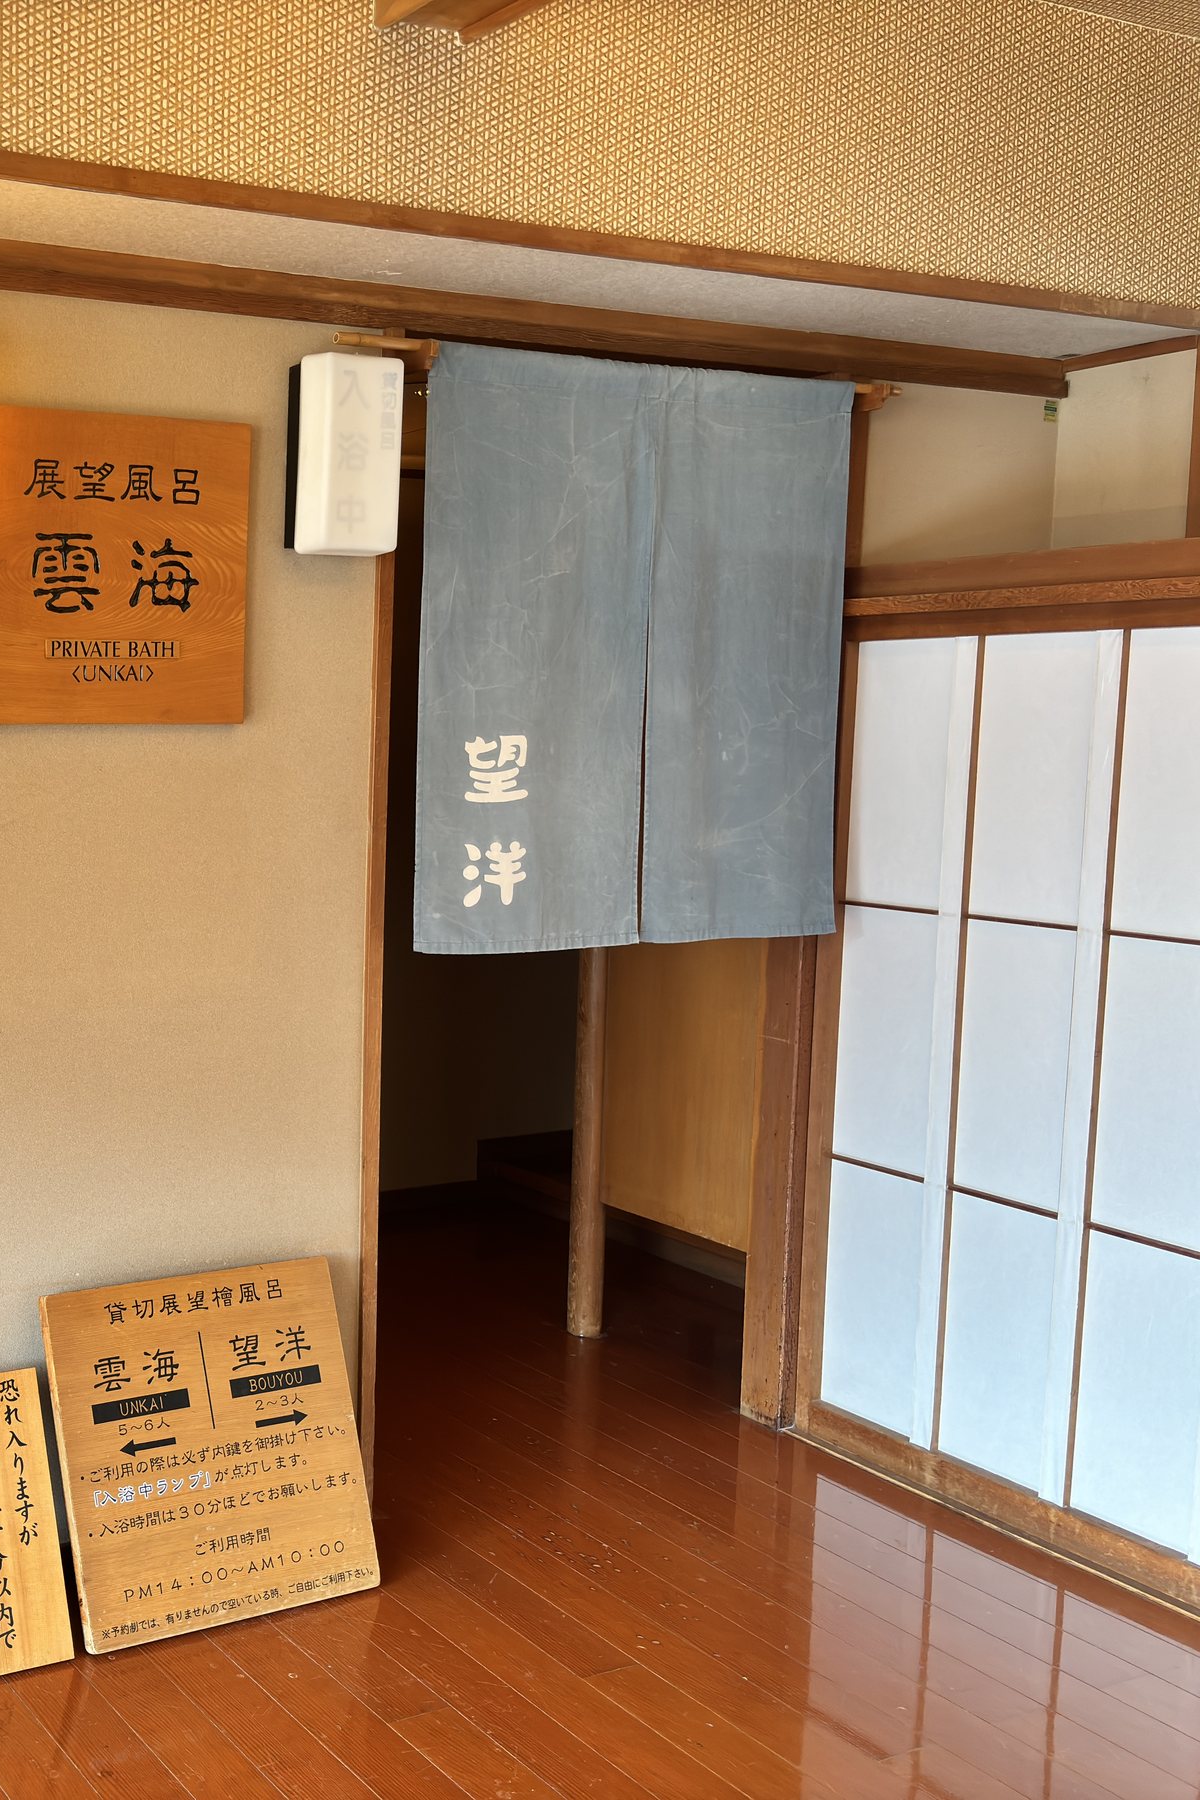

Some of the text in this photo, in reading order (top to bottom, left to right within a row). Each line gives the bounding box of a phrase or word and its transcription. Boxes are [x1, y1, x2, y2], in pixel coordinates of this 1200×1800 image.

[23, 458, 200, 505] 展望風呂
[32, 532, 200, 613] 雲海
[50, 640, 175, 658] PRIVATE BATH
[462, 735, 529, 908] 望洋
[103, 1279, 283, 1325] 貸切展望檜風呂
[93, 1348, 180, 1392] 雲海
[228, 1325, 312, 1372] 望洋
[249, 1370, 304, 1393] BOUYOU
[119, 1395, 165, 1417] UNKAI
[0, 1378, 39, 1547] 恐れ入りますが
[194, 1526, 272, 1557] ご利用時間
